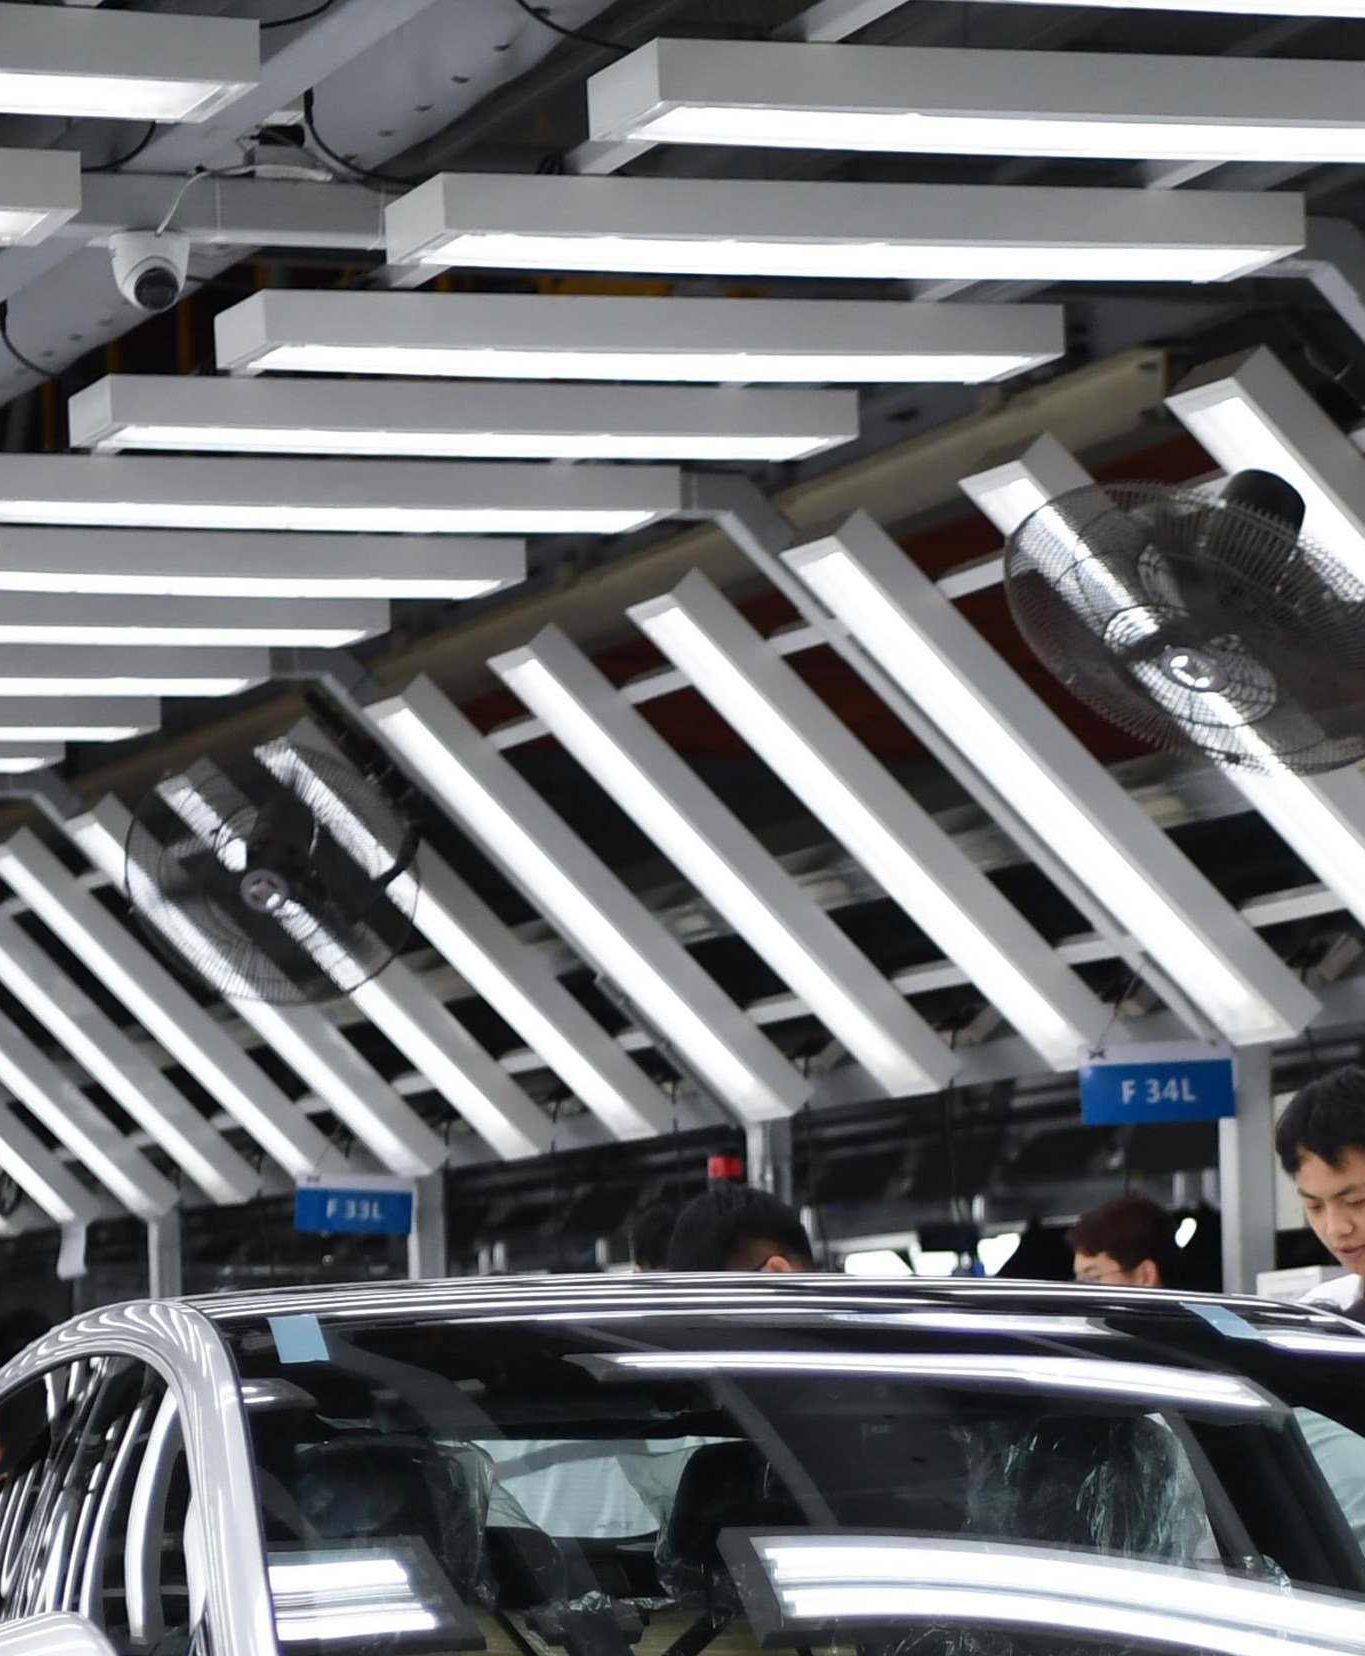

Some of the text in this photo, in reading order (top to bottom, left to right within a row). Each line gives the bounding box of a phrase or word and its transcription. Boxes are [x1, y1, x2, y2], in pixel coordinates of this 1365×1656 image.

[1121, 1077, 1197, 1105] F 34L
[325, 1198, 338, 1219] F
